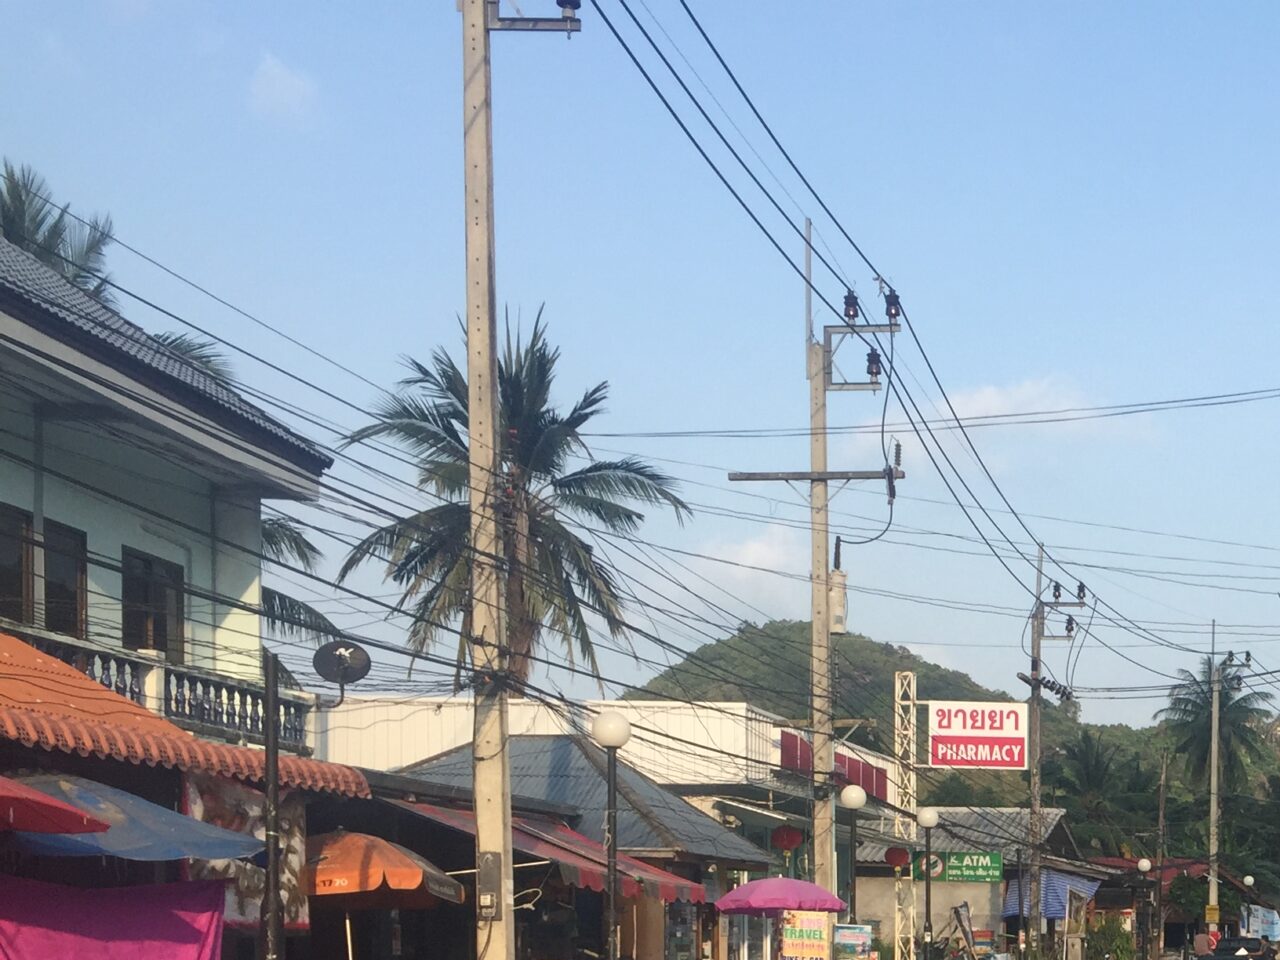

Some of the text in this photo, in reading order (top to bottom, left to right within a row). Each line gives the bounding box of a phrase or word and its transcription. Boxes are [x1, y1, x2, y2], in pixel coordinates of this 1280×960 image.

[936, 708, 1019, 731] ขายยา
[937, 743, 1022, 762] PHARMACY
[963, 855, 992, 867] ATM
[320, 878, 349, 888] 1770
[784, 928, 825, 940] TRAVEL
